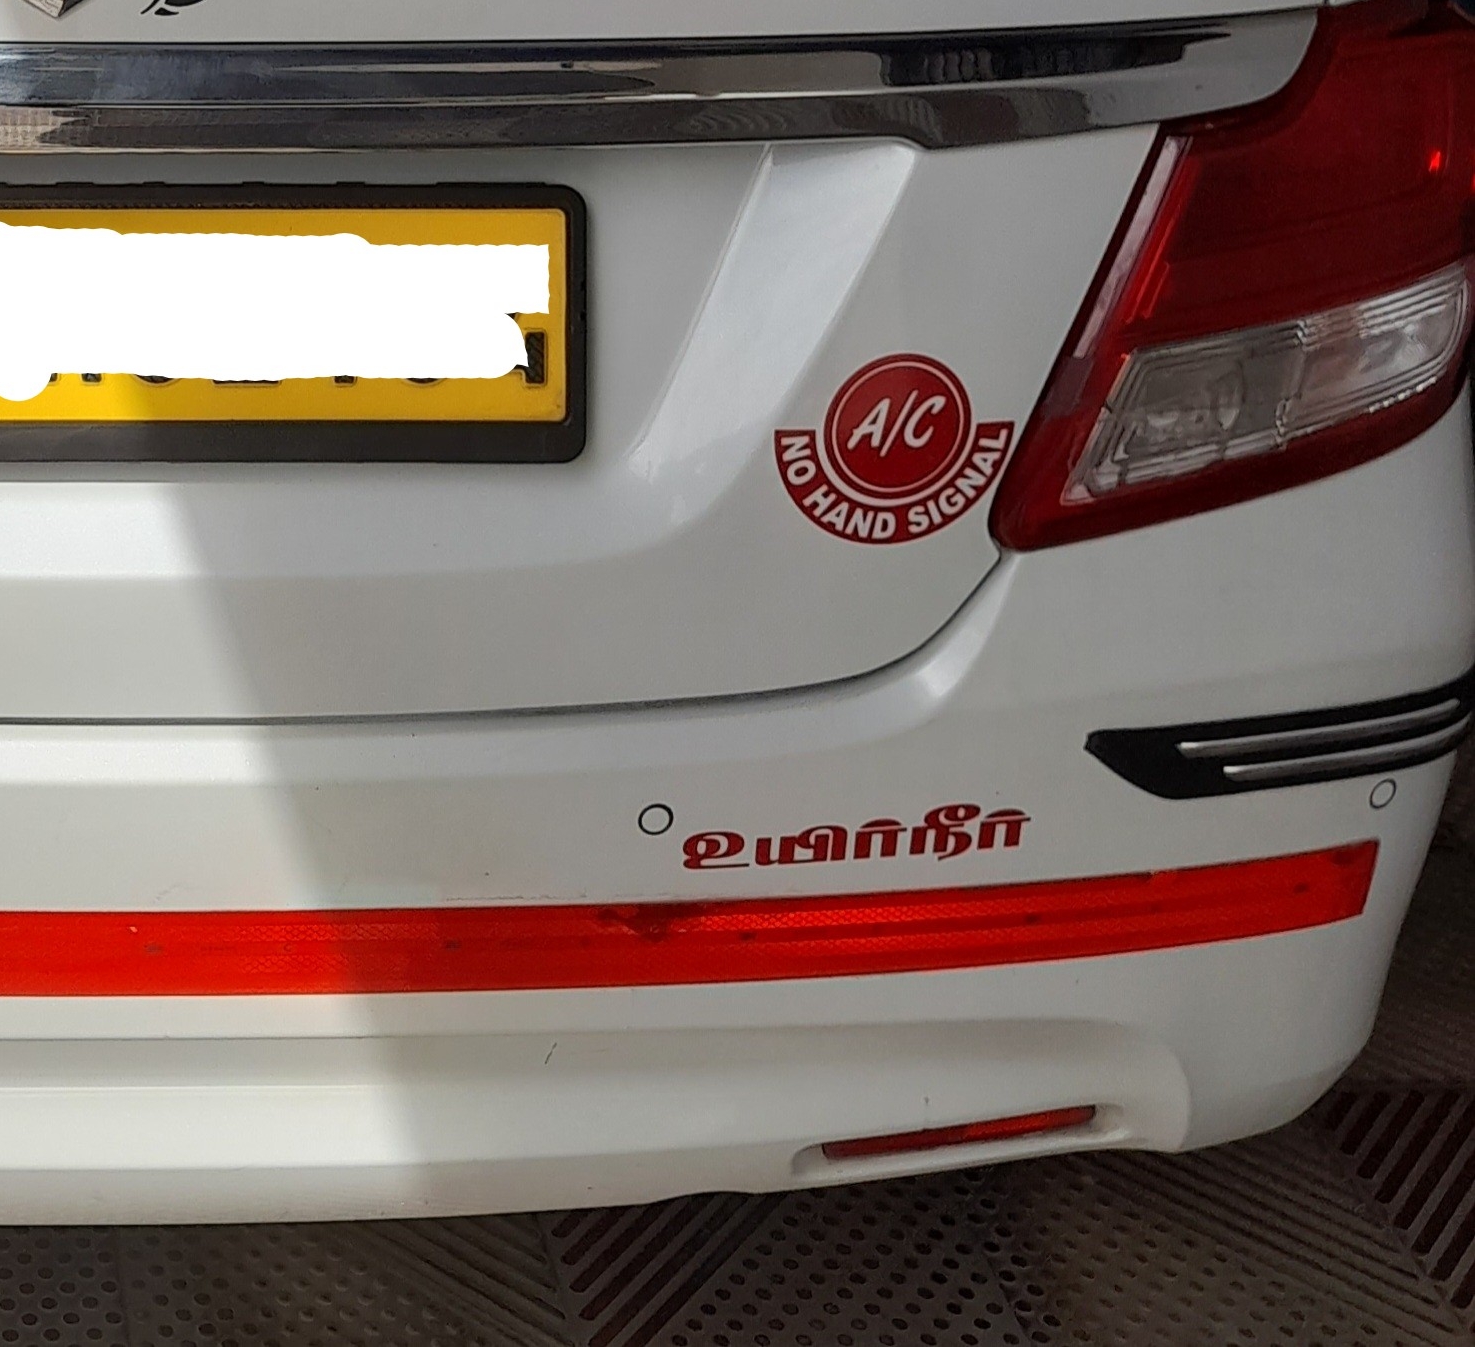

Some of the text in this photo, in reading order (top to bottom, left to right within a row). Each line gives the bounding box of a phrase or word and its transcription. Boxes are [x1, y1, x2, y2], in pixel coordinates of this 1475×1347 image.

[846, 390, 947, 458] A/C
[780, 427, 1009, 540] NO HAND SIGNAL
[682, 803, 1032, 870] உயிர்நீர்
